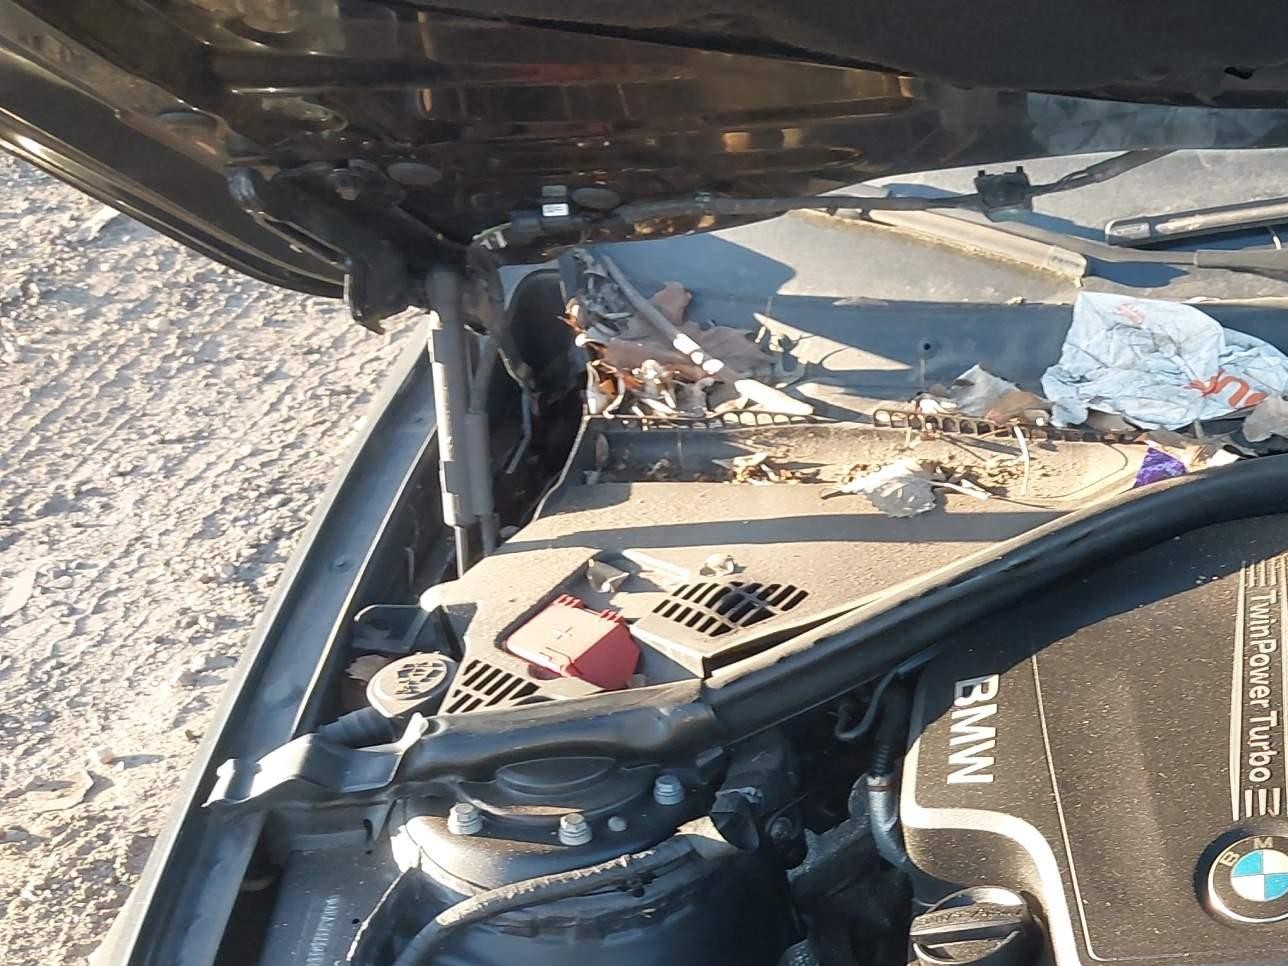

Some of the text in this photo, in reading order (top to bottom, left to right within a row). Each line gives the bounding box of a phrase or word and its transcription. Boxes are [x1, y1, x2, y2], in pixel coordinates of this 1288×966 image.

[947, 674, 999, 784] BMW
[1248, 591, 1277, 782] TwinPower Turbo
